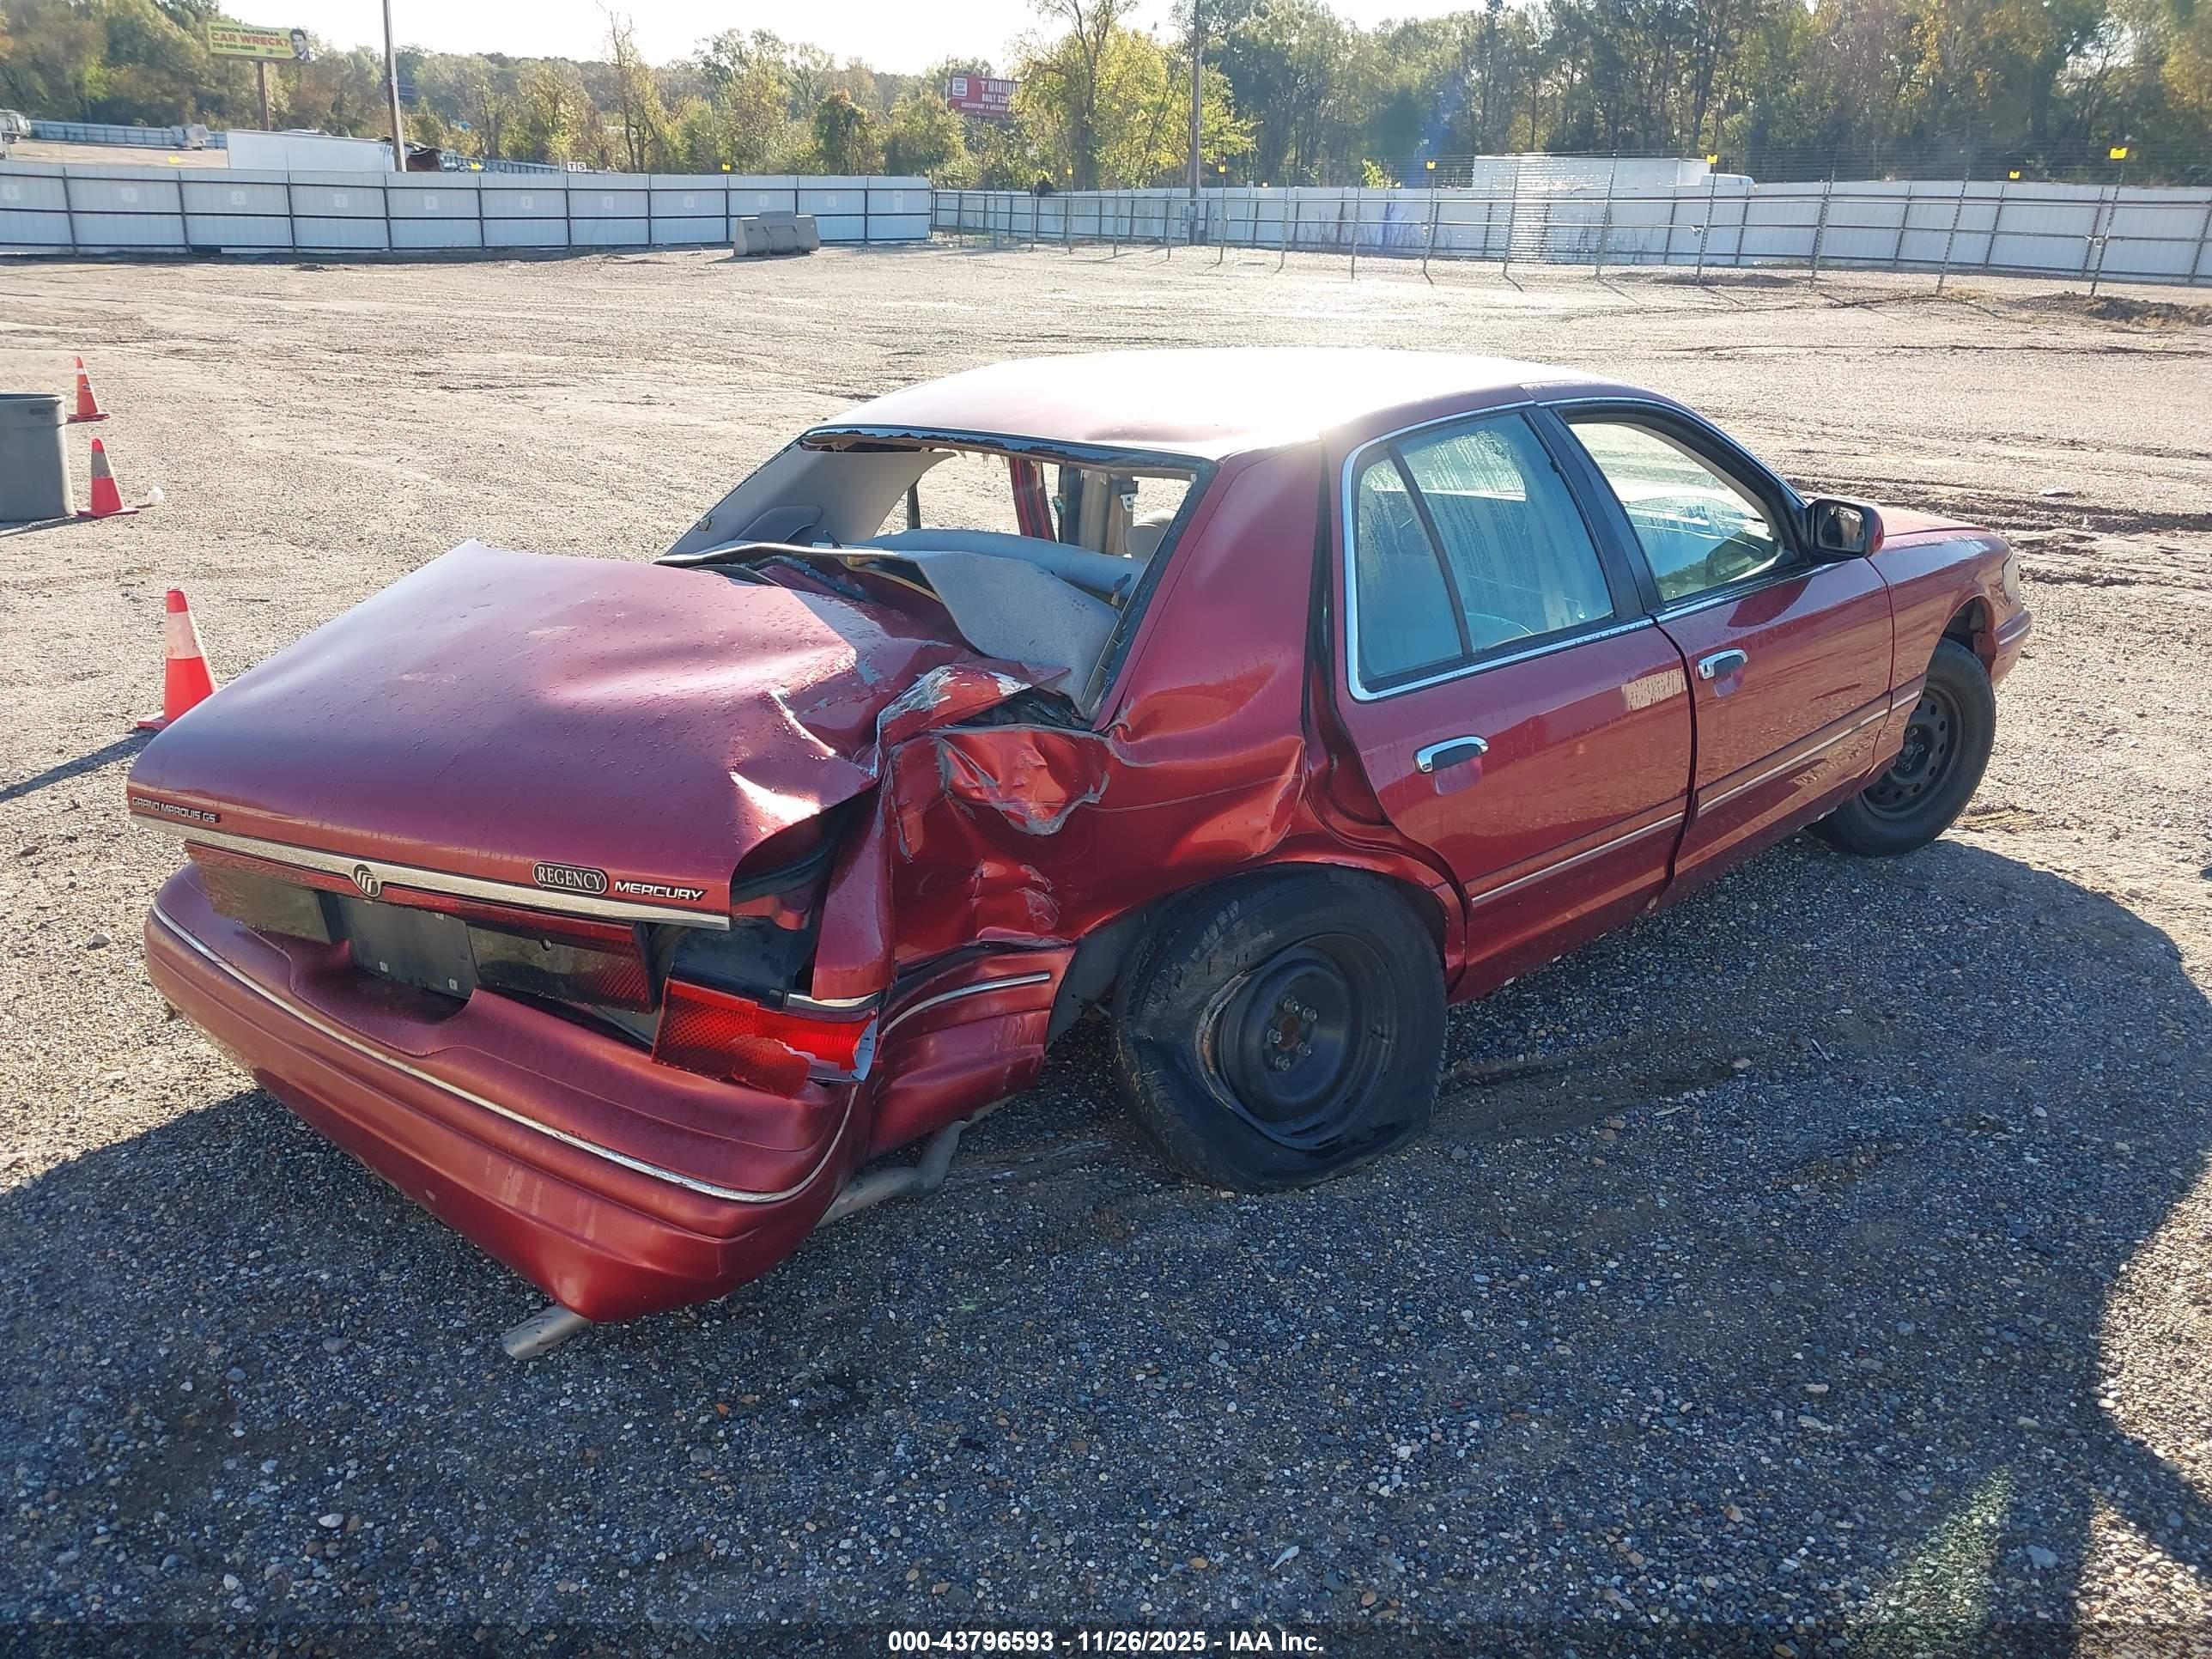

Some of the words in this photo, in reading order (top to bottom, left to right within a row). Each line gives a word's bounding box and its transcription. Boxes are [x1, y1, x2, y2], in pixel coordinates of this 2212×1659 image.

[212, 33, 236, 41] CAR
[240, 35, 289, 46] WRECK?
[131, 797, 160, 811] GRAND
[161, 801, 201, 821] MARQUIS
[203, 811, 216, 823] GS
[538, 866, 602, 890] REGENCY
[614, 880, 703, 901] MERCURY
